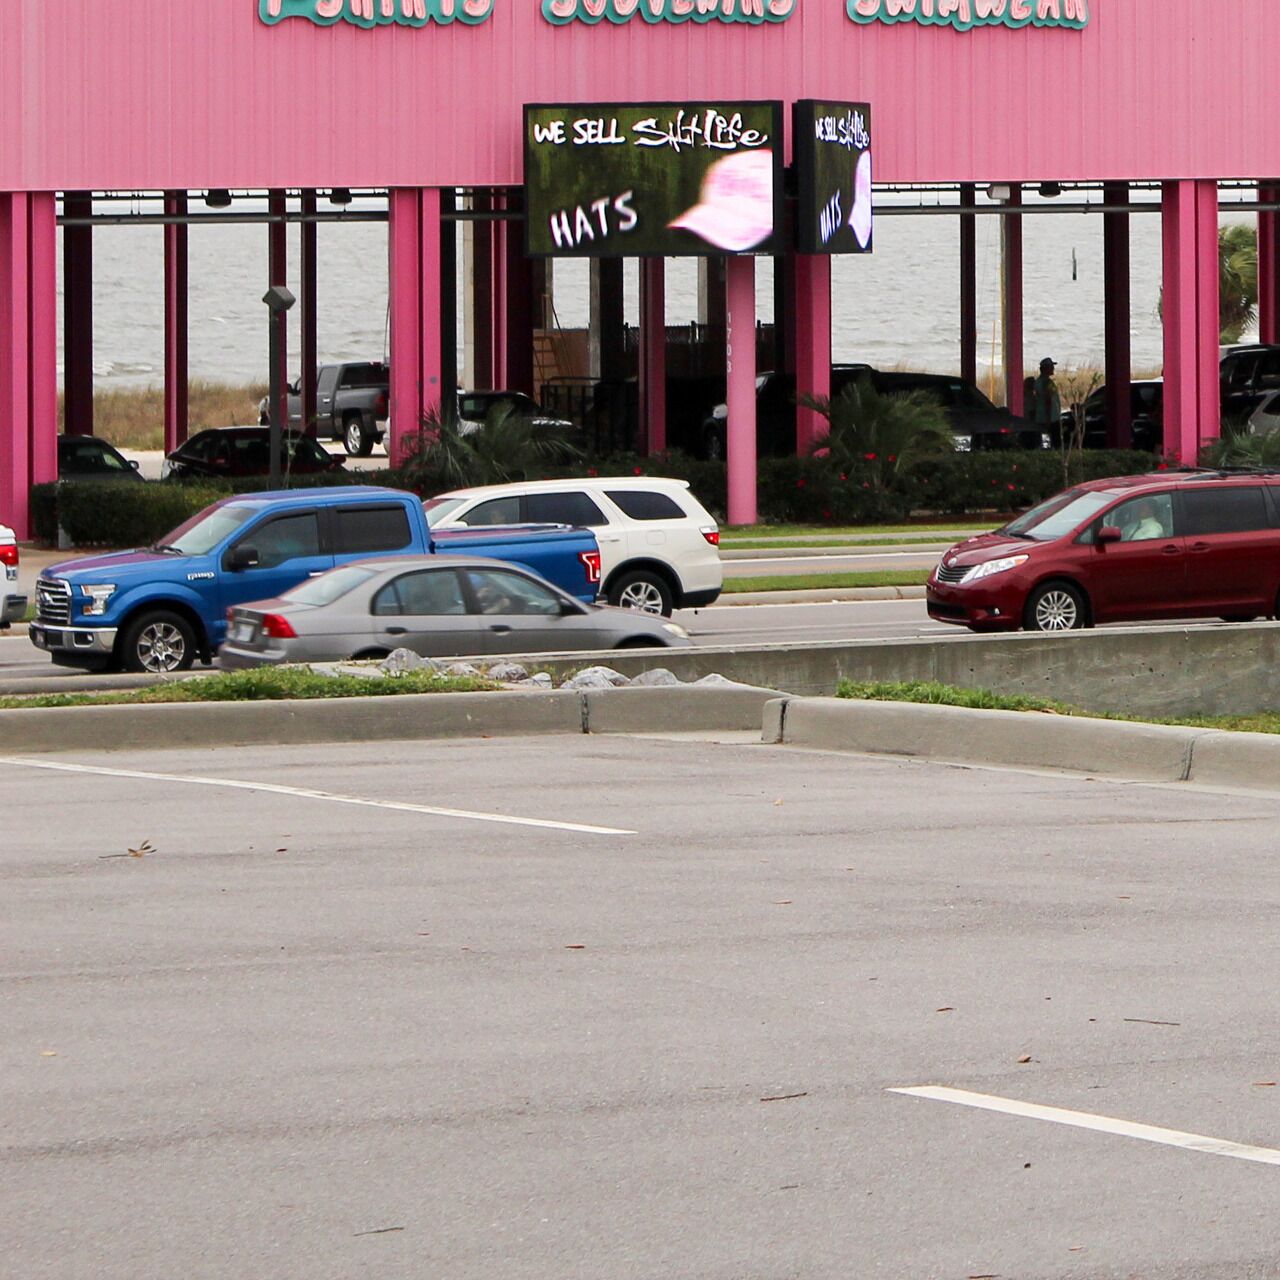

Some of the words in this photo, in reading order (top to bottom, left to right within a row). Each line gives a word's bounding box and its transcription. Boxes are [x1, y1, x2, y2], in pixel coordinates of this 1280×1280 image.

[533, 119, 566, 145] WE
[572, 117, 626, 145] SELL
[701, 109, 769, 150] Life
[815, 117, 825, 141] WE
[824, 116, 838, 142] SELL
[550, 189, 638, 248] HATS
[820, 188, 842, 244] HATS
